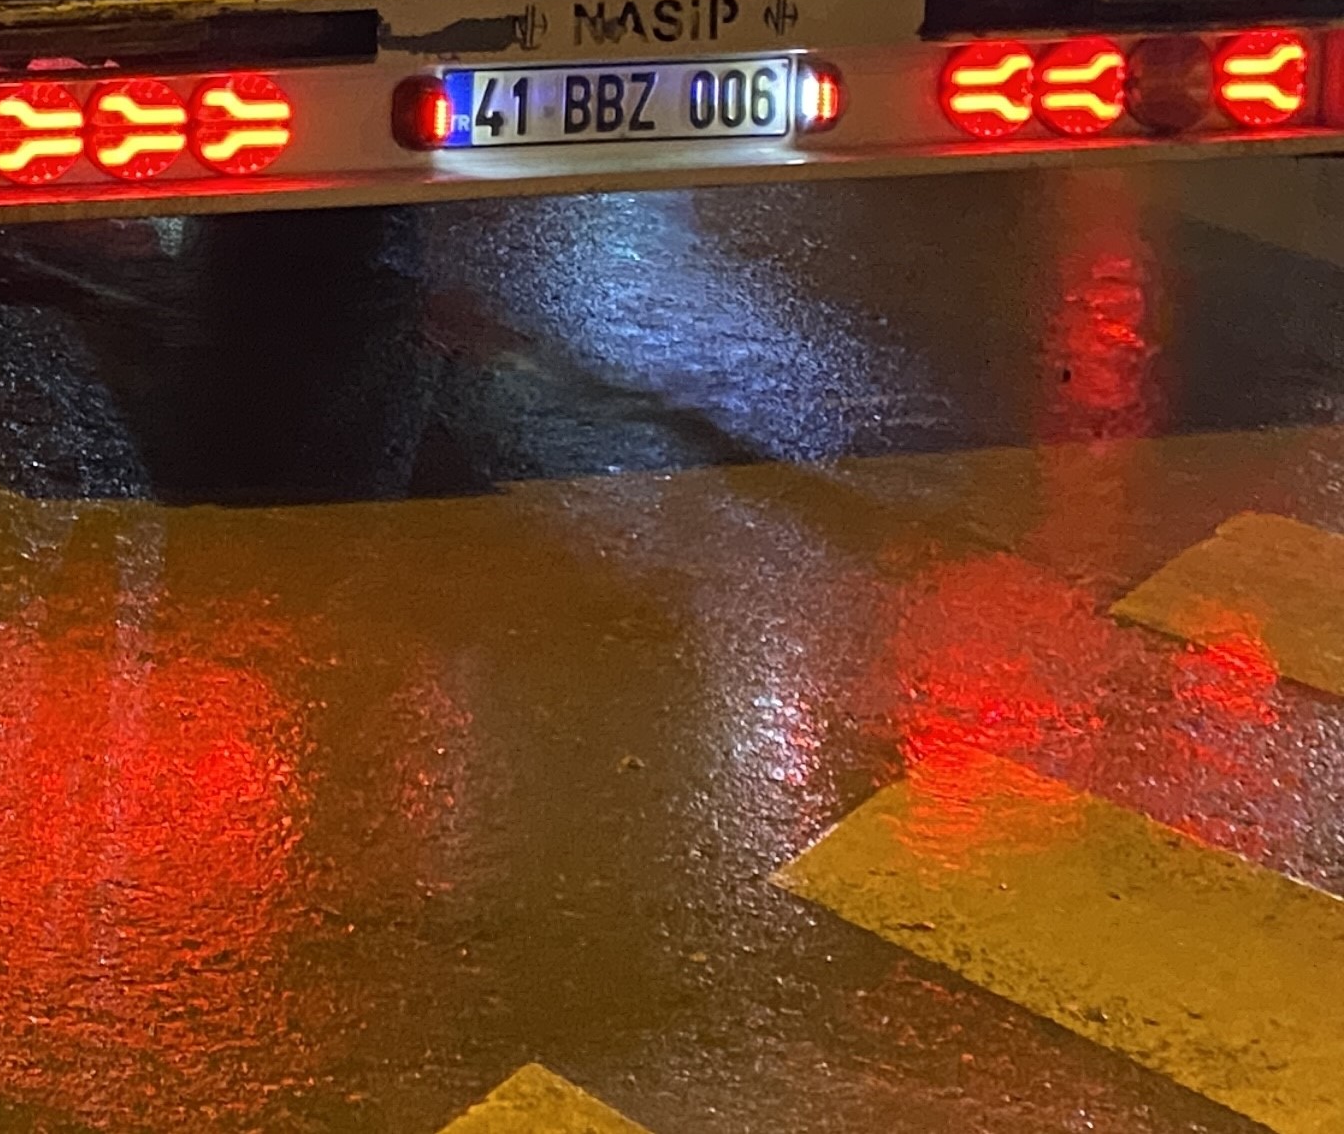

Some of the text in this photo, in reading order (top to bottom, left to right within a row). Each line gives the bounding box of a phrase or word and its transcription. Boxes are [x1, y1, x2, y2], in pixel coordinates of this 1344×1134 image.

[474, 76, 528, 137] 41
[564, 71, 657, 134] BBZ
[689, 68, 778, 130] 006
